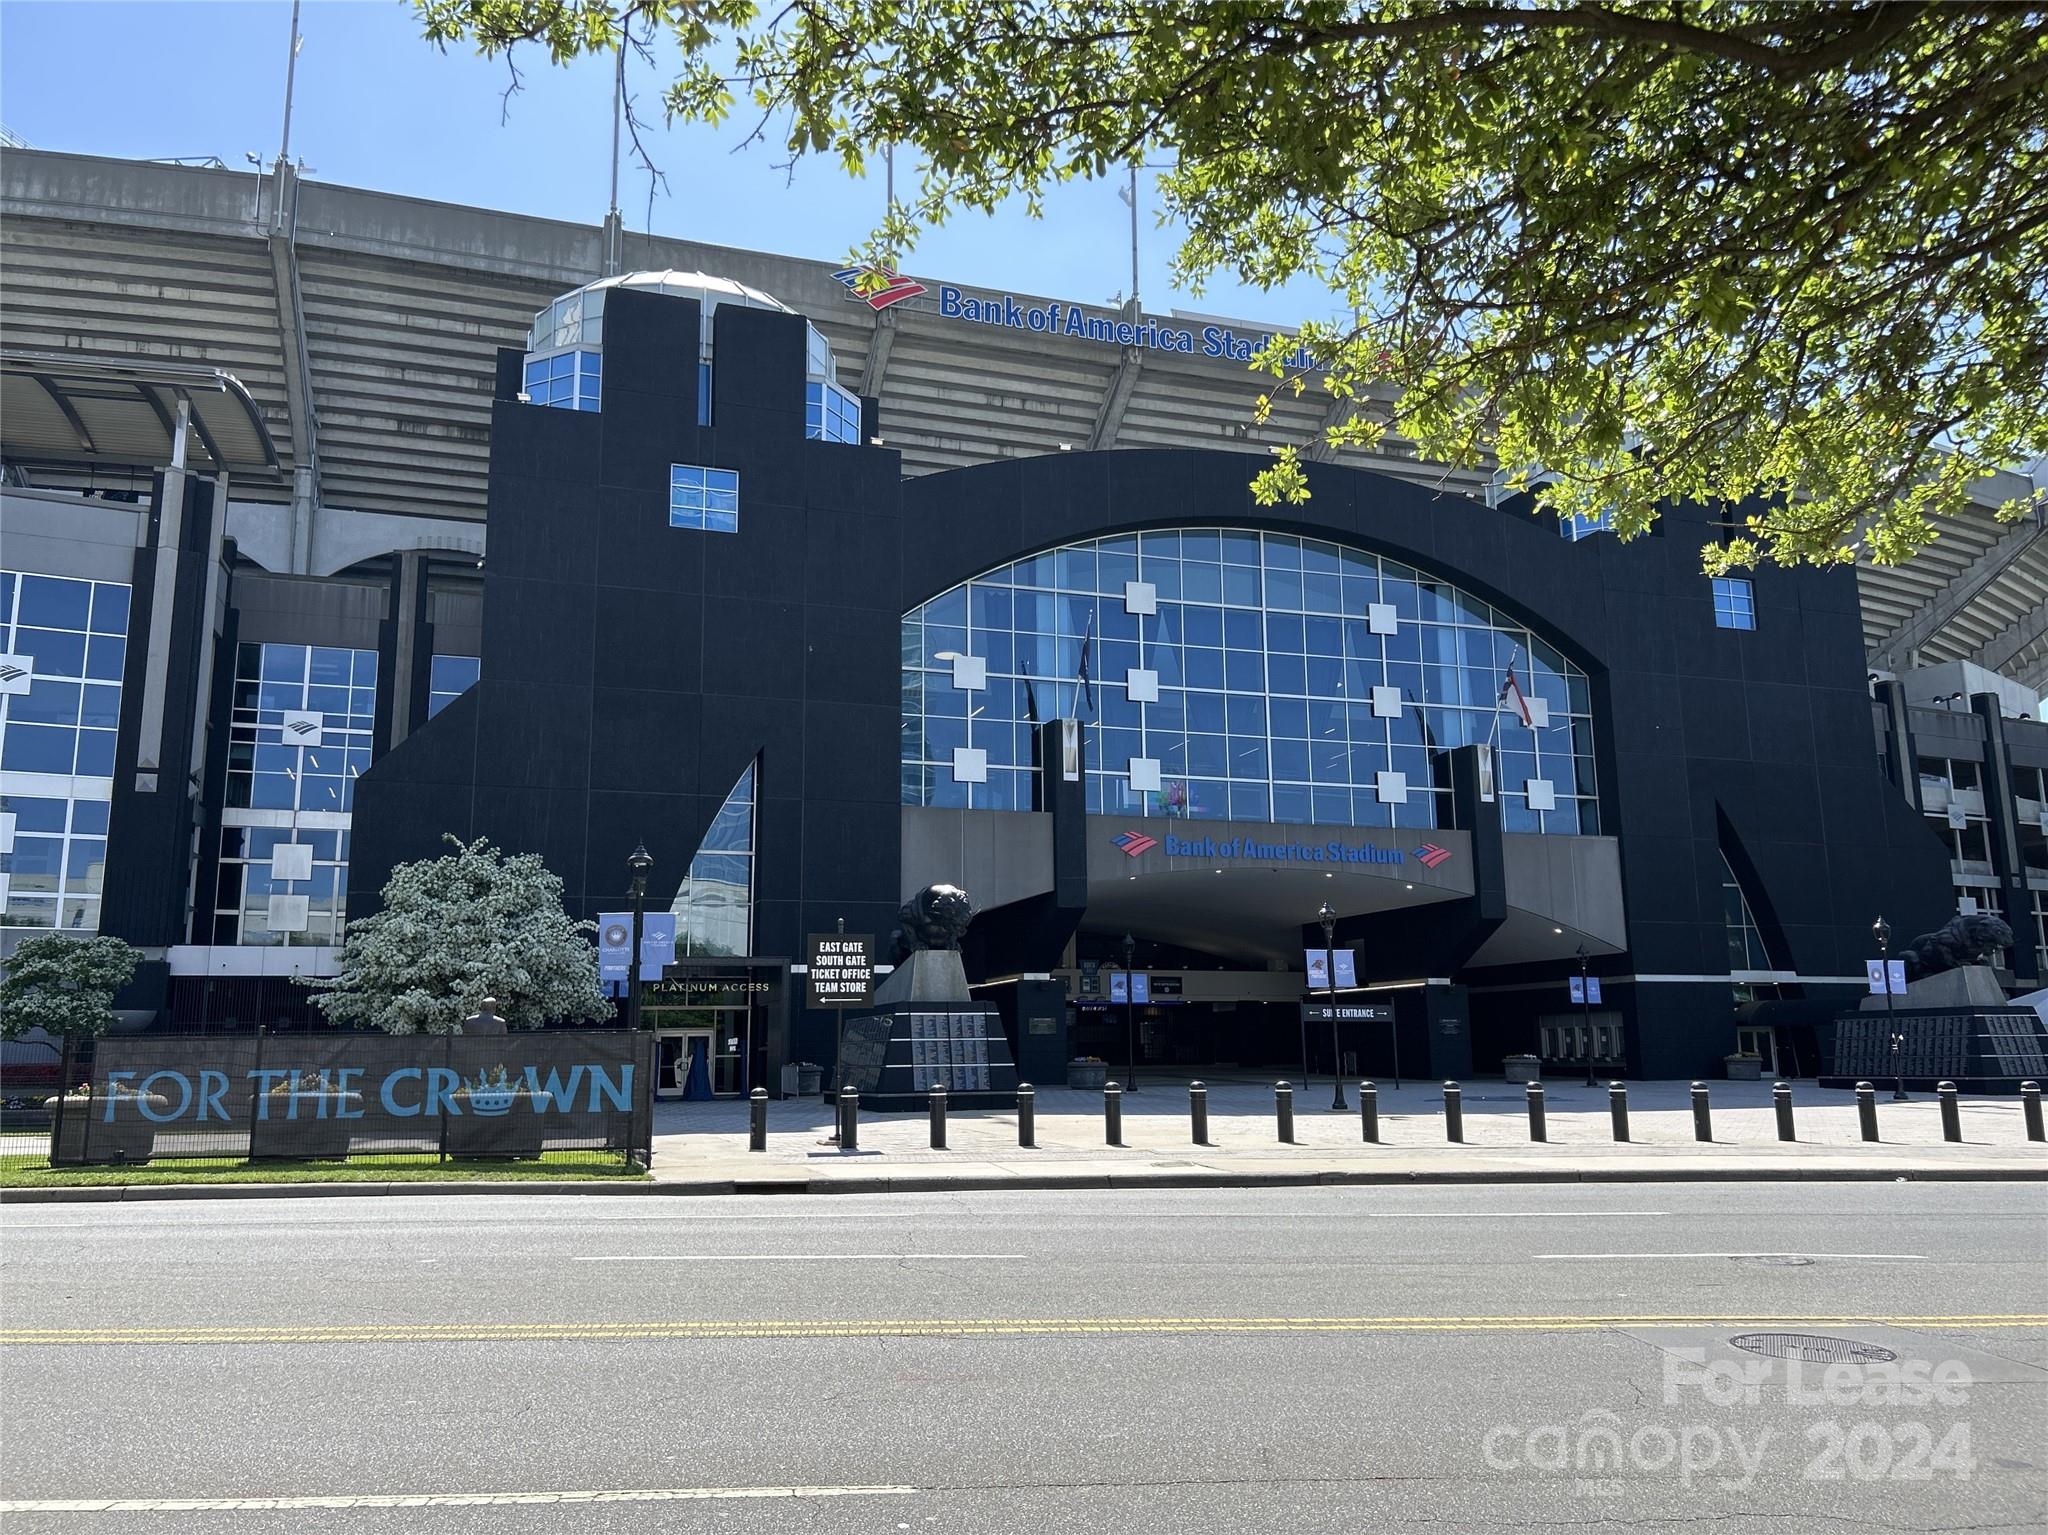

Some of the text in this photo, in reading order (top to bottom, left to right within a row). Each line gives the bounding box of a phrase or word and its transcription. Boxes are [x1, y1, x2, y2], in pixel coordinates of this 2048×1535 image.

[939, 285, 1024, 328] Bank
[1026, 303, 1061, 334] of
[1064, 306, 1194, 354] America
[1165, 834, 1405, 865] Bank of America Stadium
[820, 942, 863, 952] EAST GATE
[816, 955, 866, 966] SOUTH GATE
[811, 968, 871, 979] TICKET OFFICE
[653, 983, 769, 992] PLATINUM ACCESS
[815, 982, 866, 992] TEAM STORE
[1322, 1008, 1375, 1018] SUIE ENTRANCE
[103, 1070, 232, 1122] FOR
[247, 1068, 367, 1120] THE
